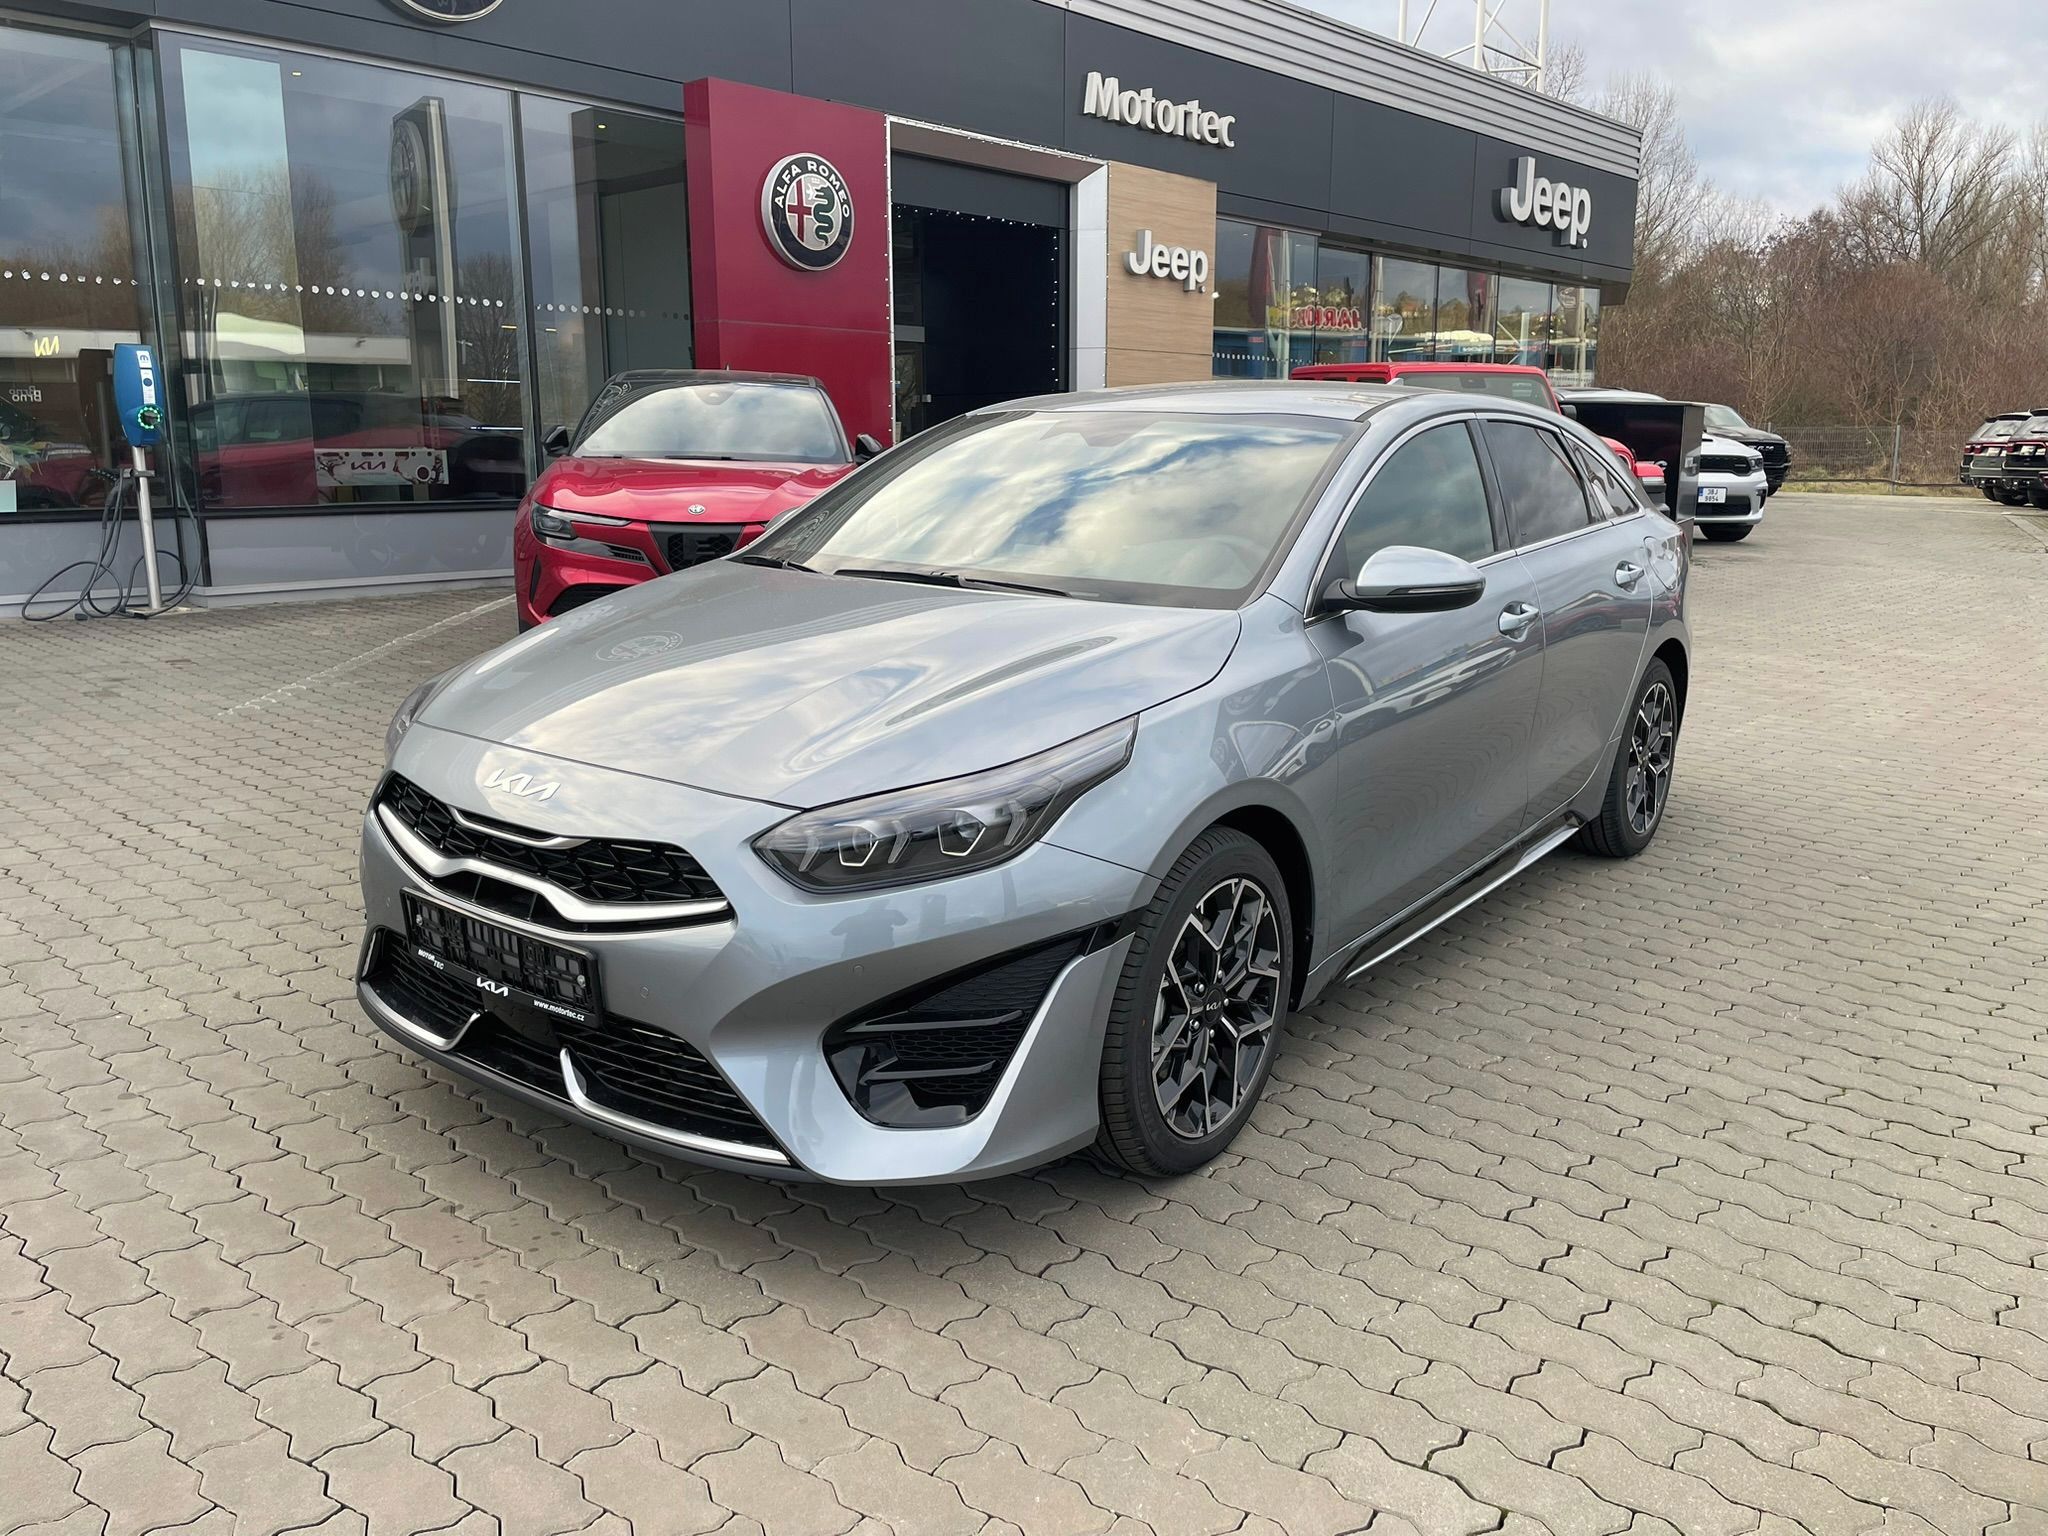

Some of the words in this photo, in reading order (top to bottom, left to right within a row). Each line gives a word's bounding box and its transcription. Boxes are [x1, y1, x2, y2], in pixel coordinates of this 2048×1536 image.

[1083, 71, 1236, 148] Motortec
[774, 164, 802, 208] ALFA
[806, 160, 850, 218] ROMEO
[1501, 156, 1592, 247] Jeep
[1122, 228, 1209, 292] Jeep
[351, 461, 386, 471] KIA
[483, 768, 561, 802] KIA
[418, 949, 436, 962] MOTOR
[433, 957, 445, 970] TEC
[477, 976, 509, 997] KIA
[533, 999, 585, 1022] www.motortec.cz
